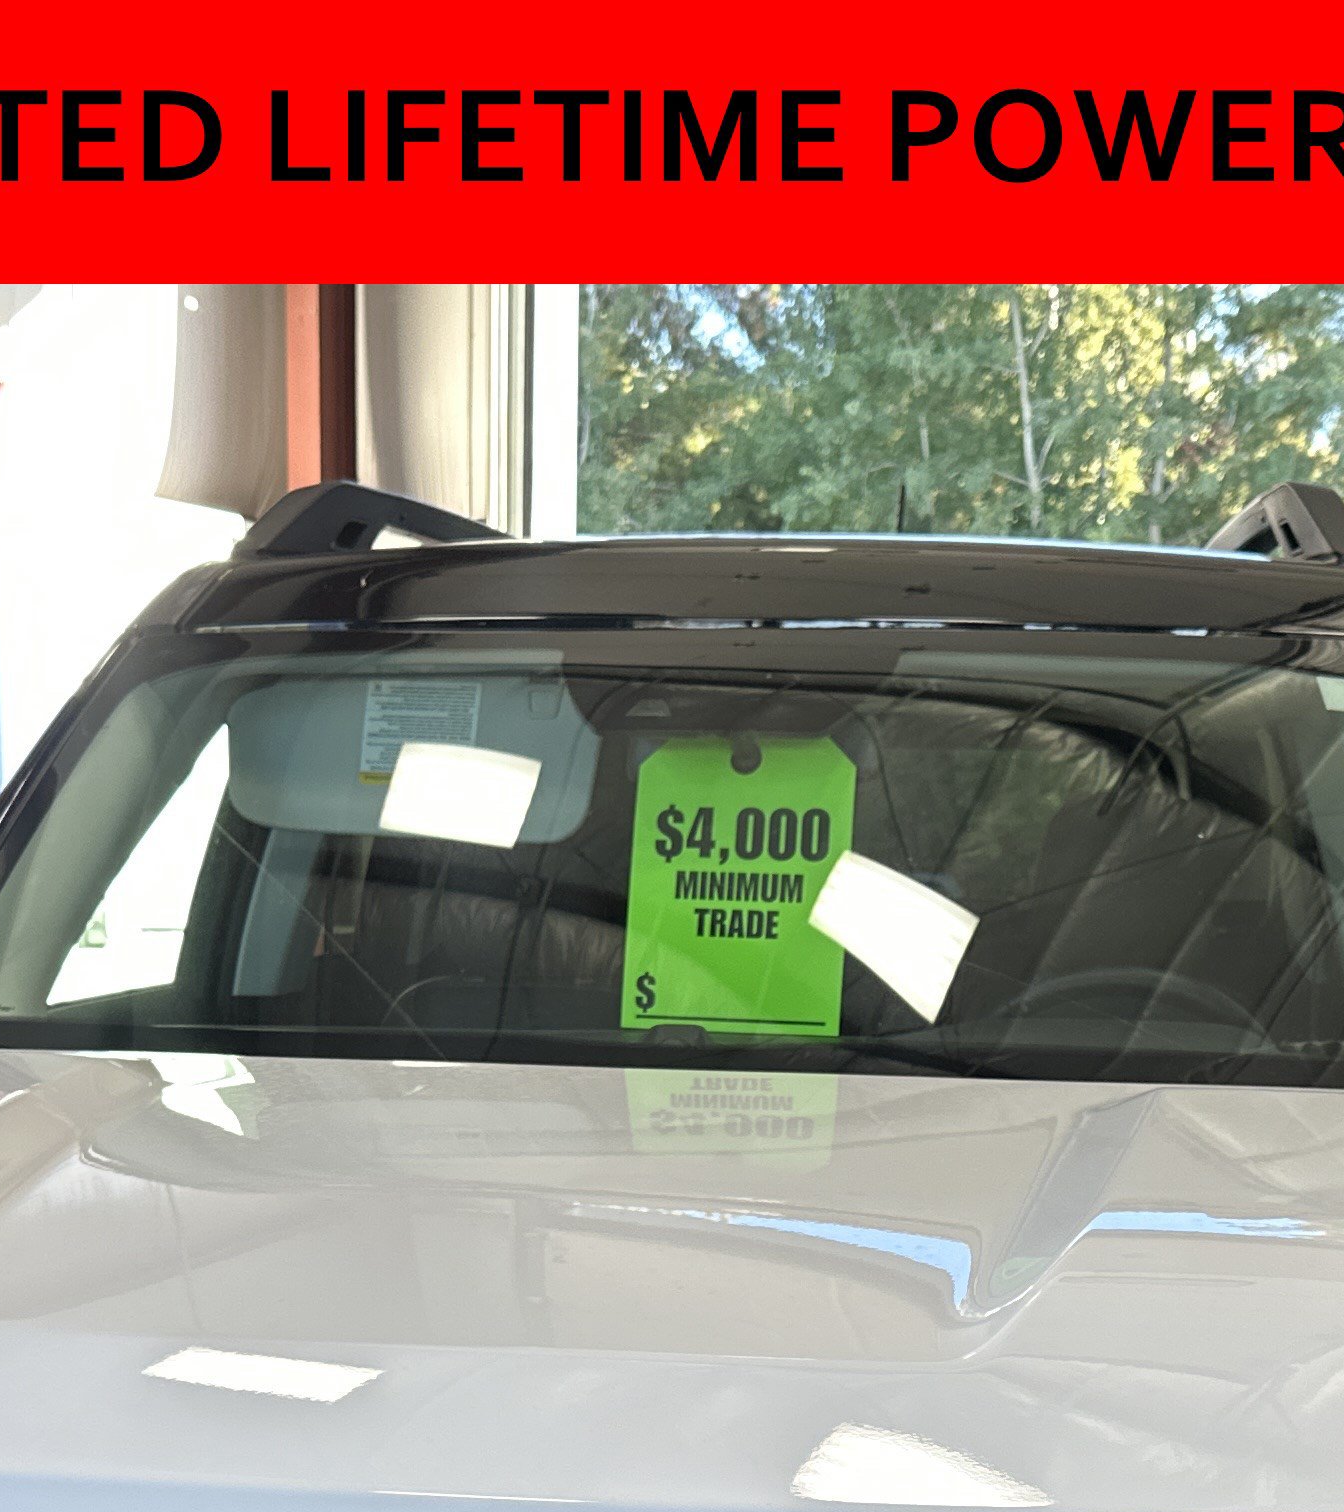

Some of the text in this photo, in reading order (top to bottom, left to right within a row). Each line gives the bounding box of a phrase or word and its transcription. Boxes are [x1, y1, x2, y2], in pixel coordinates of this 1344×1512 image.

[655, 805, 830, 864] $4,000
[674, 871, 804, 903] MINIMUM
[694, 908, 779, 940] TRADE
[635, 971, 655, 1013] $
